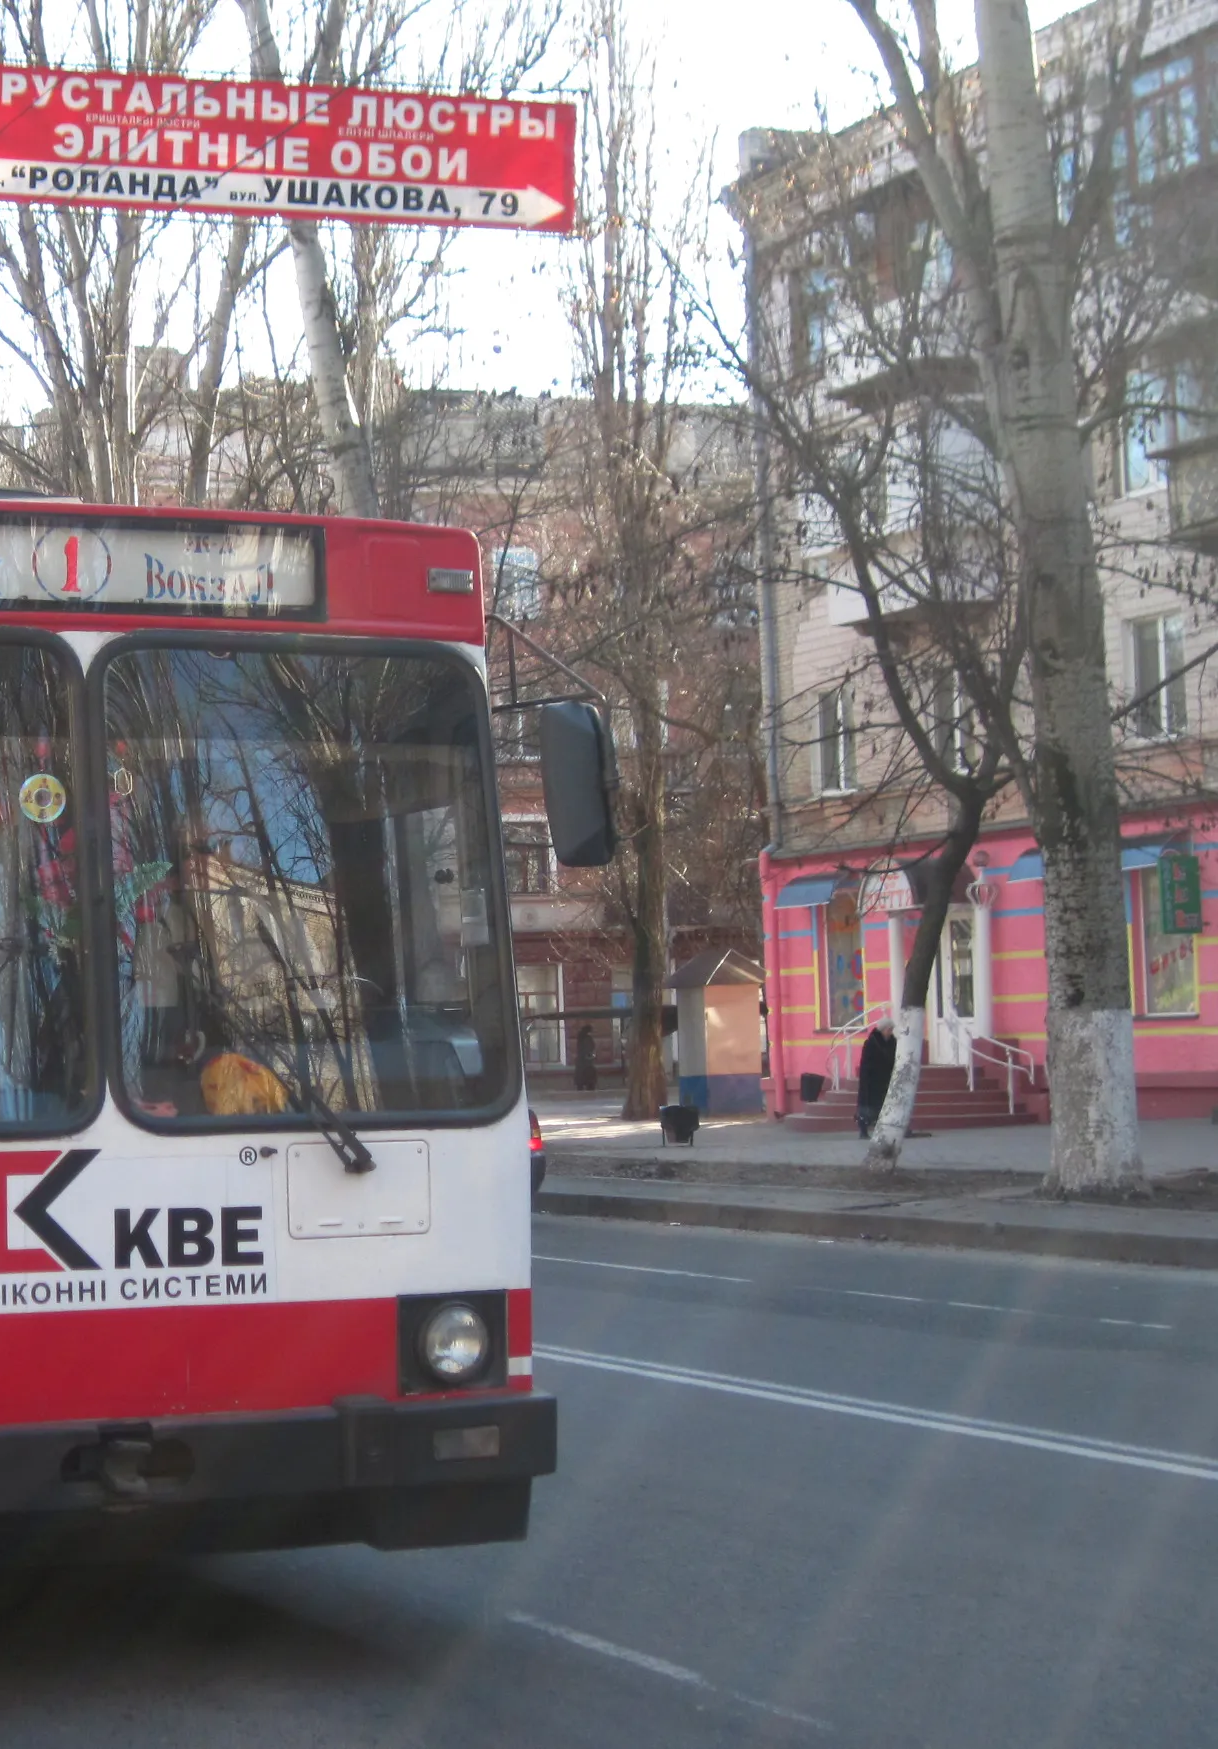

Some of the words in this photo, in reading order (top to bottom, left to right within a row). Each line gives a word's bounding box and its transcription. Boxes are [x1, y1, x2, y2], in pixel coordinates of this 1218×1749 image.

[348, 95, 556, 140] ЛЮСТРЫ
[54, 123, 309, 172] ЭЛИТНЫЕ
[331, 140, 468, 181] ОБОИ
[264, 177, 462, 220] УШАКОВА,
[478, 189, 520, 217] 79
[61, 536, 82, 592] 1
[114, 1206, 264, 1269] KBE
[120, 1272, 267, 1300] СИСТЕМИ
